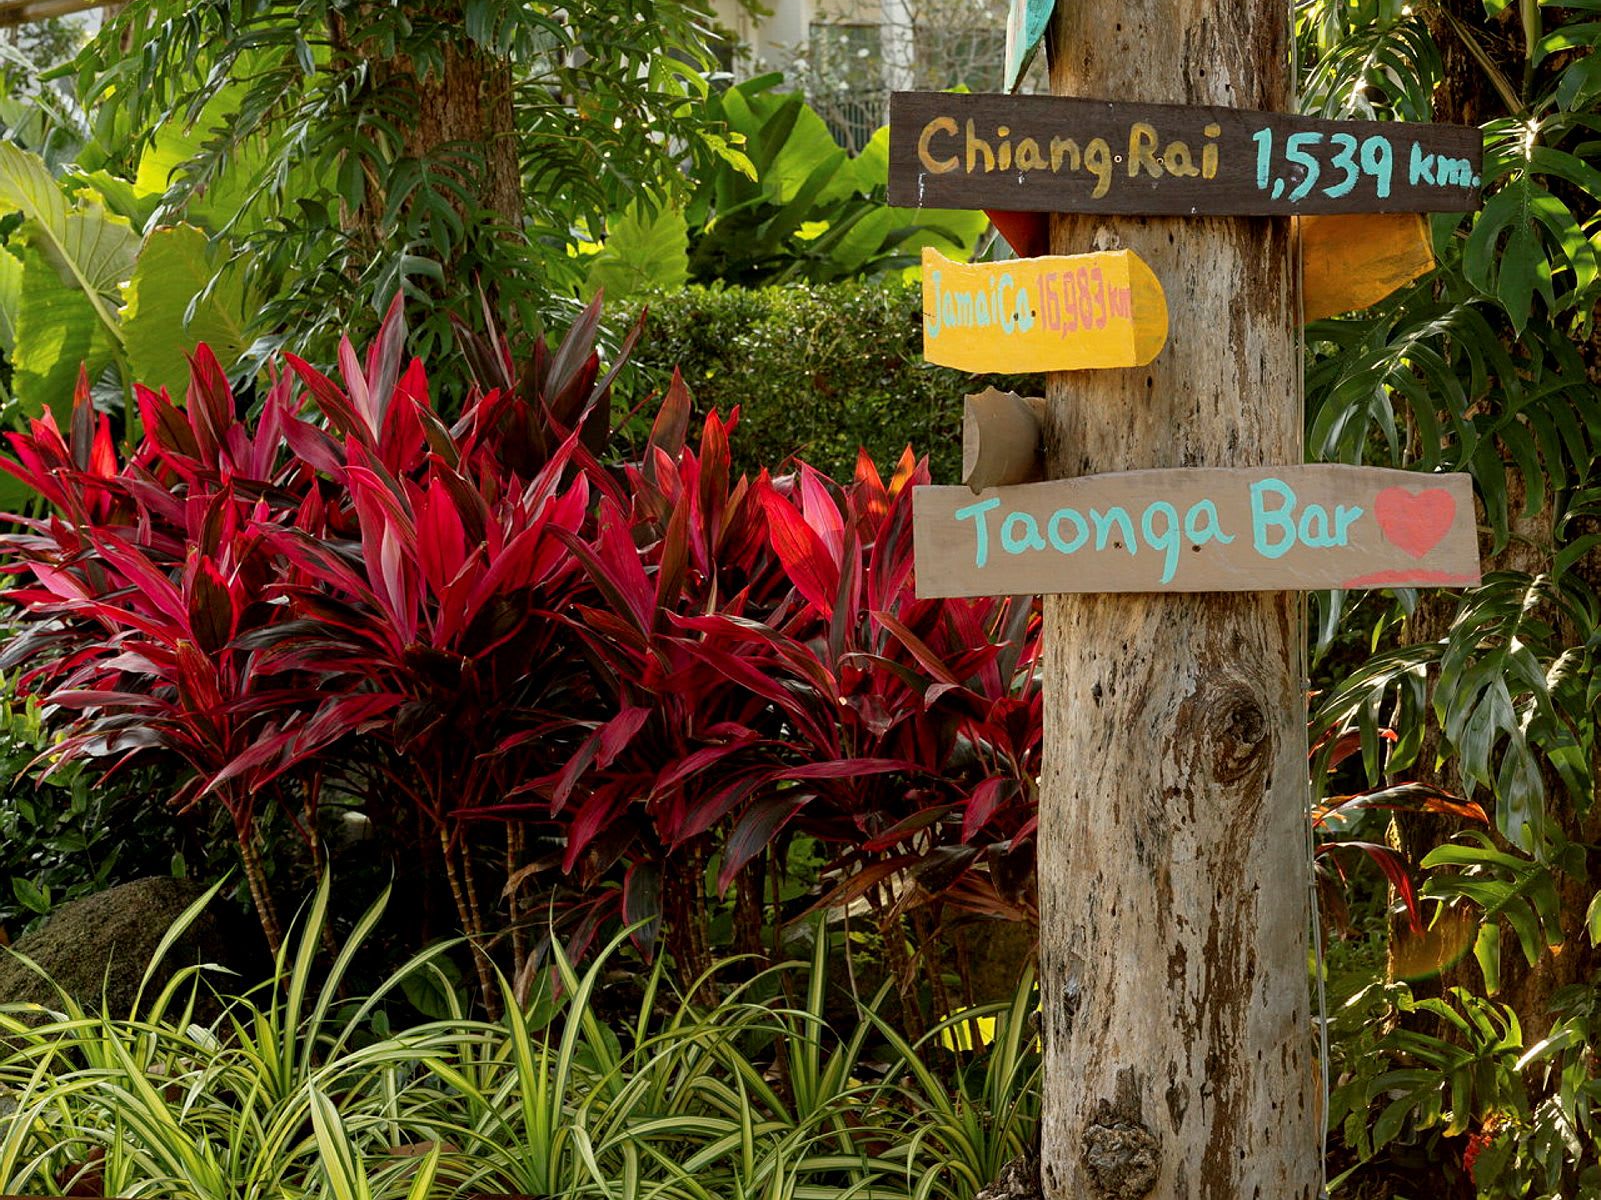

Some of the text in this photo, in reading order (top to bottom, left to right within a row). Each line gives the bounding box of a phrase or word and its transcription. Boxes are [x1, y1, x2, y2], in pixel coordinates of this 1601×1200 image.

[917, 116, 1482, 202] Chiang Rai 1,539 km.
[955, 478, 1364, 584] Taonga Bar
